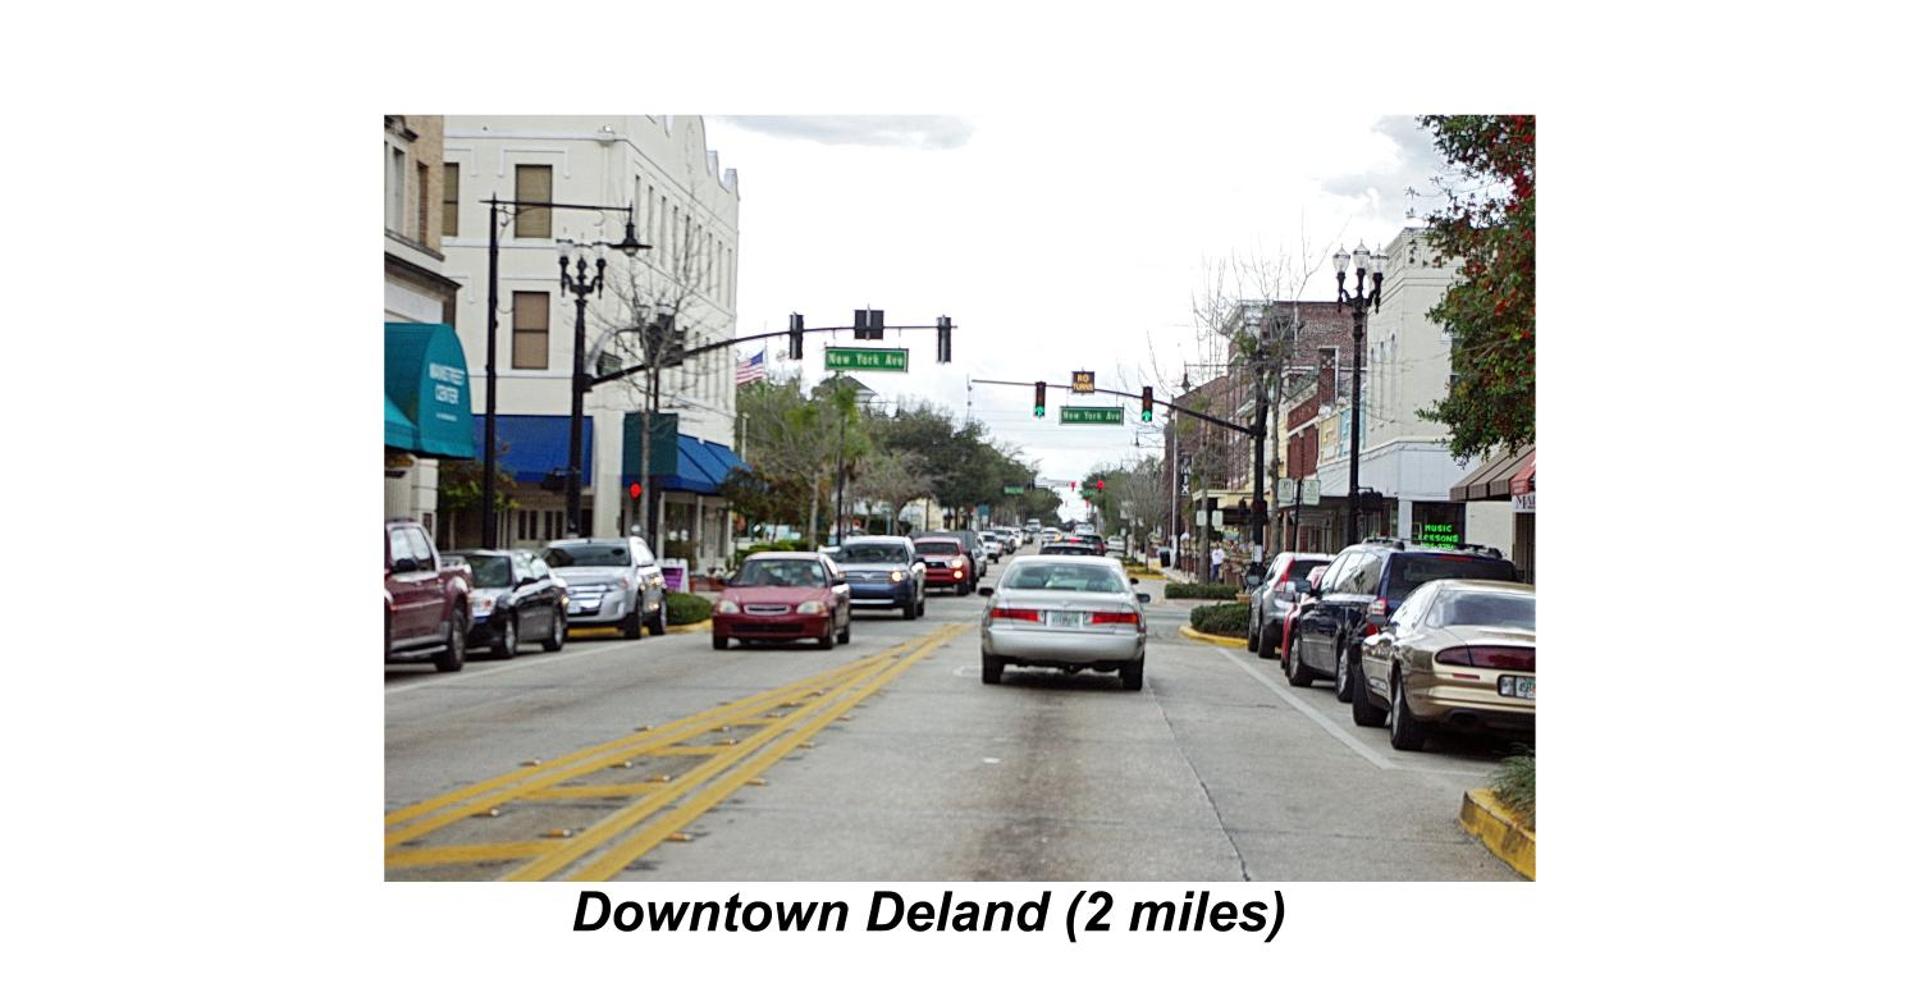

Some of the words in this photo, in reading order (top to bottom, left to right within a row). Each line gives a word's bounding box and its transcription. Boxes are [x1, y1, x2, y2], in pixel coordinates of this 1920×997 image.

[828, 352, 850, 365] New
[856, 353, 879, 366] York
[885, 354, 903, 366] Ave
[1077, 373, 1089, 382] NO
[1063, 411, 1079, 420] New
[1084, 411, 1102, 420] York
[1105, 411, 1120, 420] Ave
[1425, 524, 1452, 532] MUSIC
